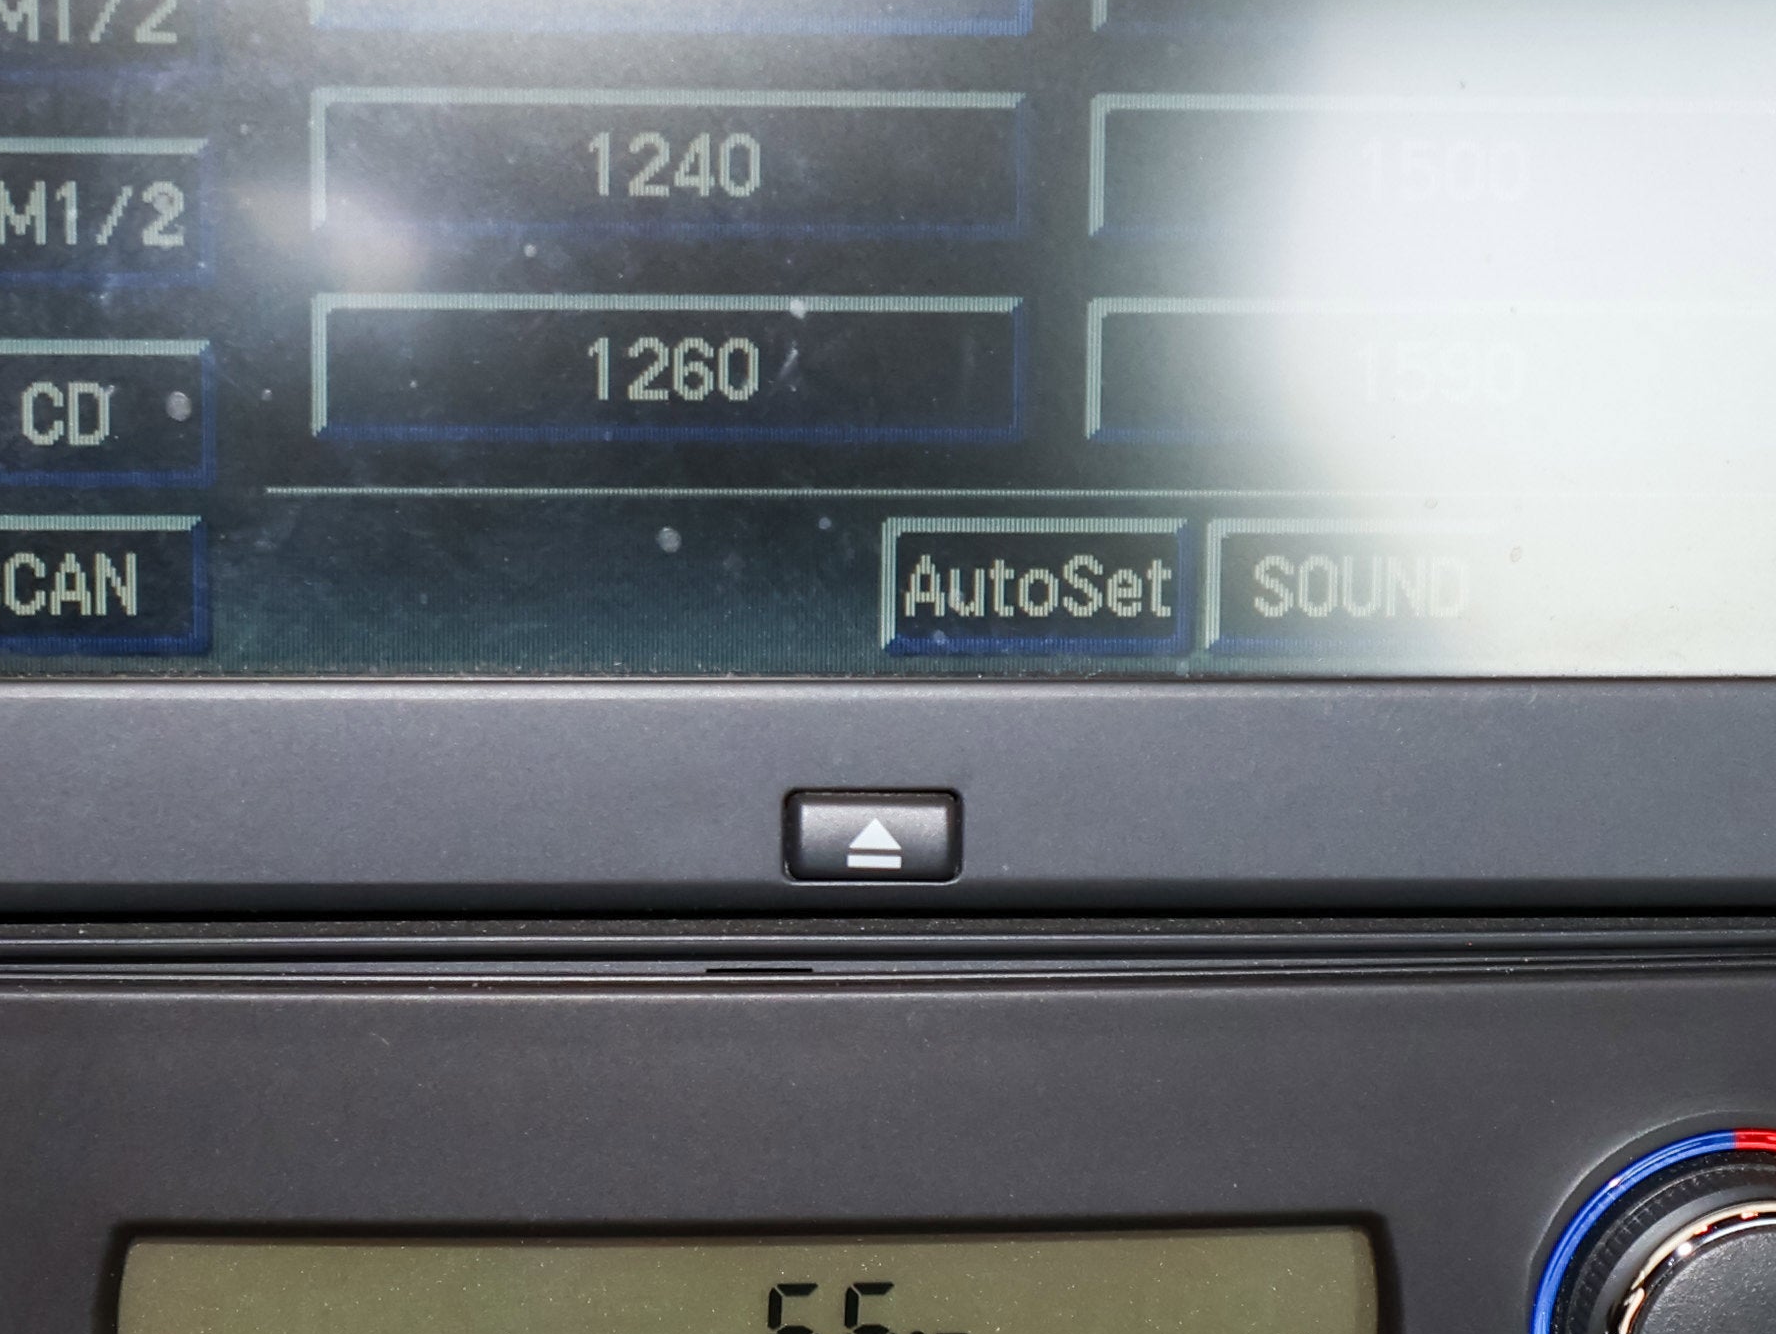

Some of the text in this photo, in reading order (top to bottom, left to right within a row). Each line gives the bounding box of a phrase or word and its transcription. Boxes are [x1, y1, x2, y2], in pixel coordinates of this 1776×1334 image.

[587, 131, 762, 198] 1240
[587, 336, 760, 402] 1260
[22, 381, 112, 447] CD
[903, 553, 1173, 619] AutoSet
[1252, 553, 1471, 619] SOUND
